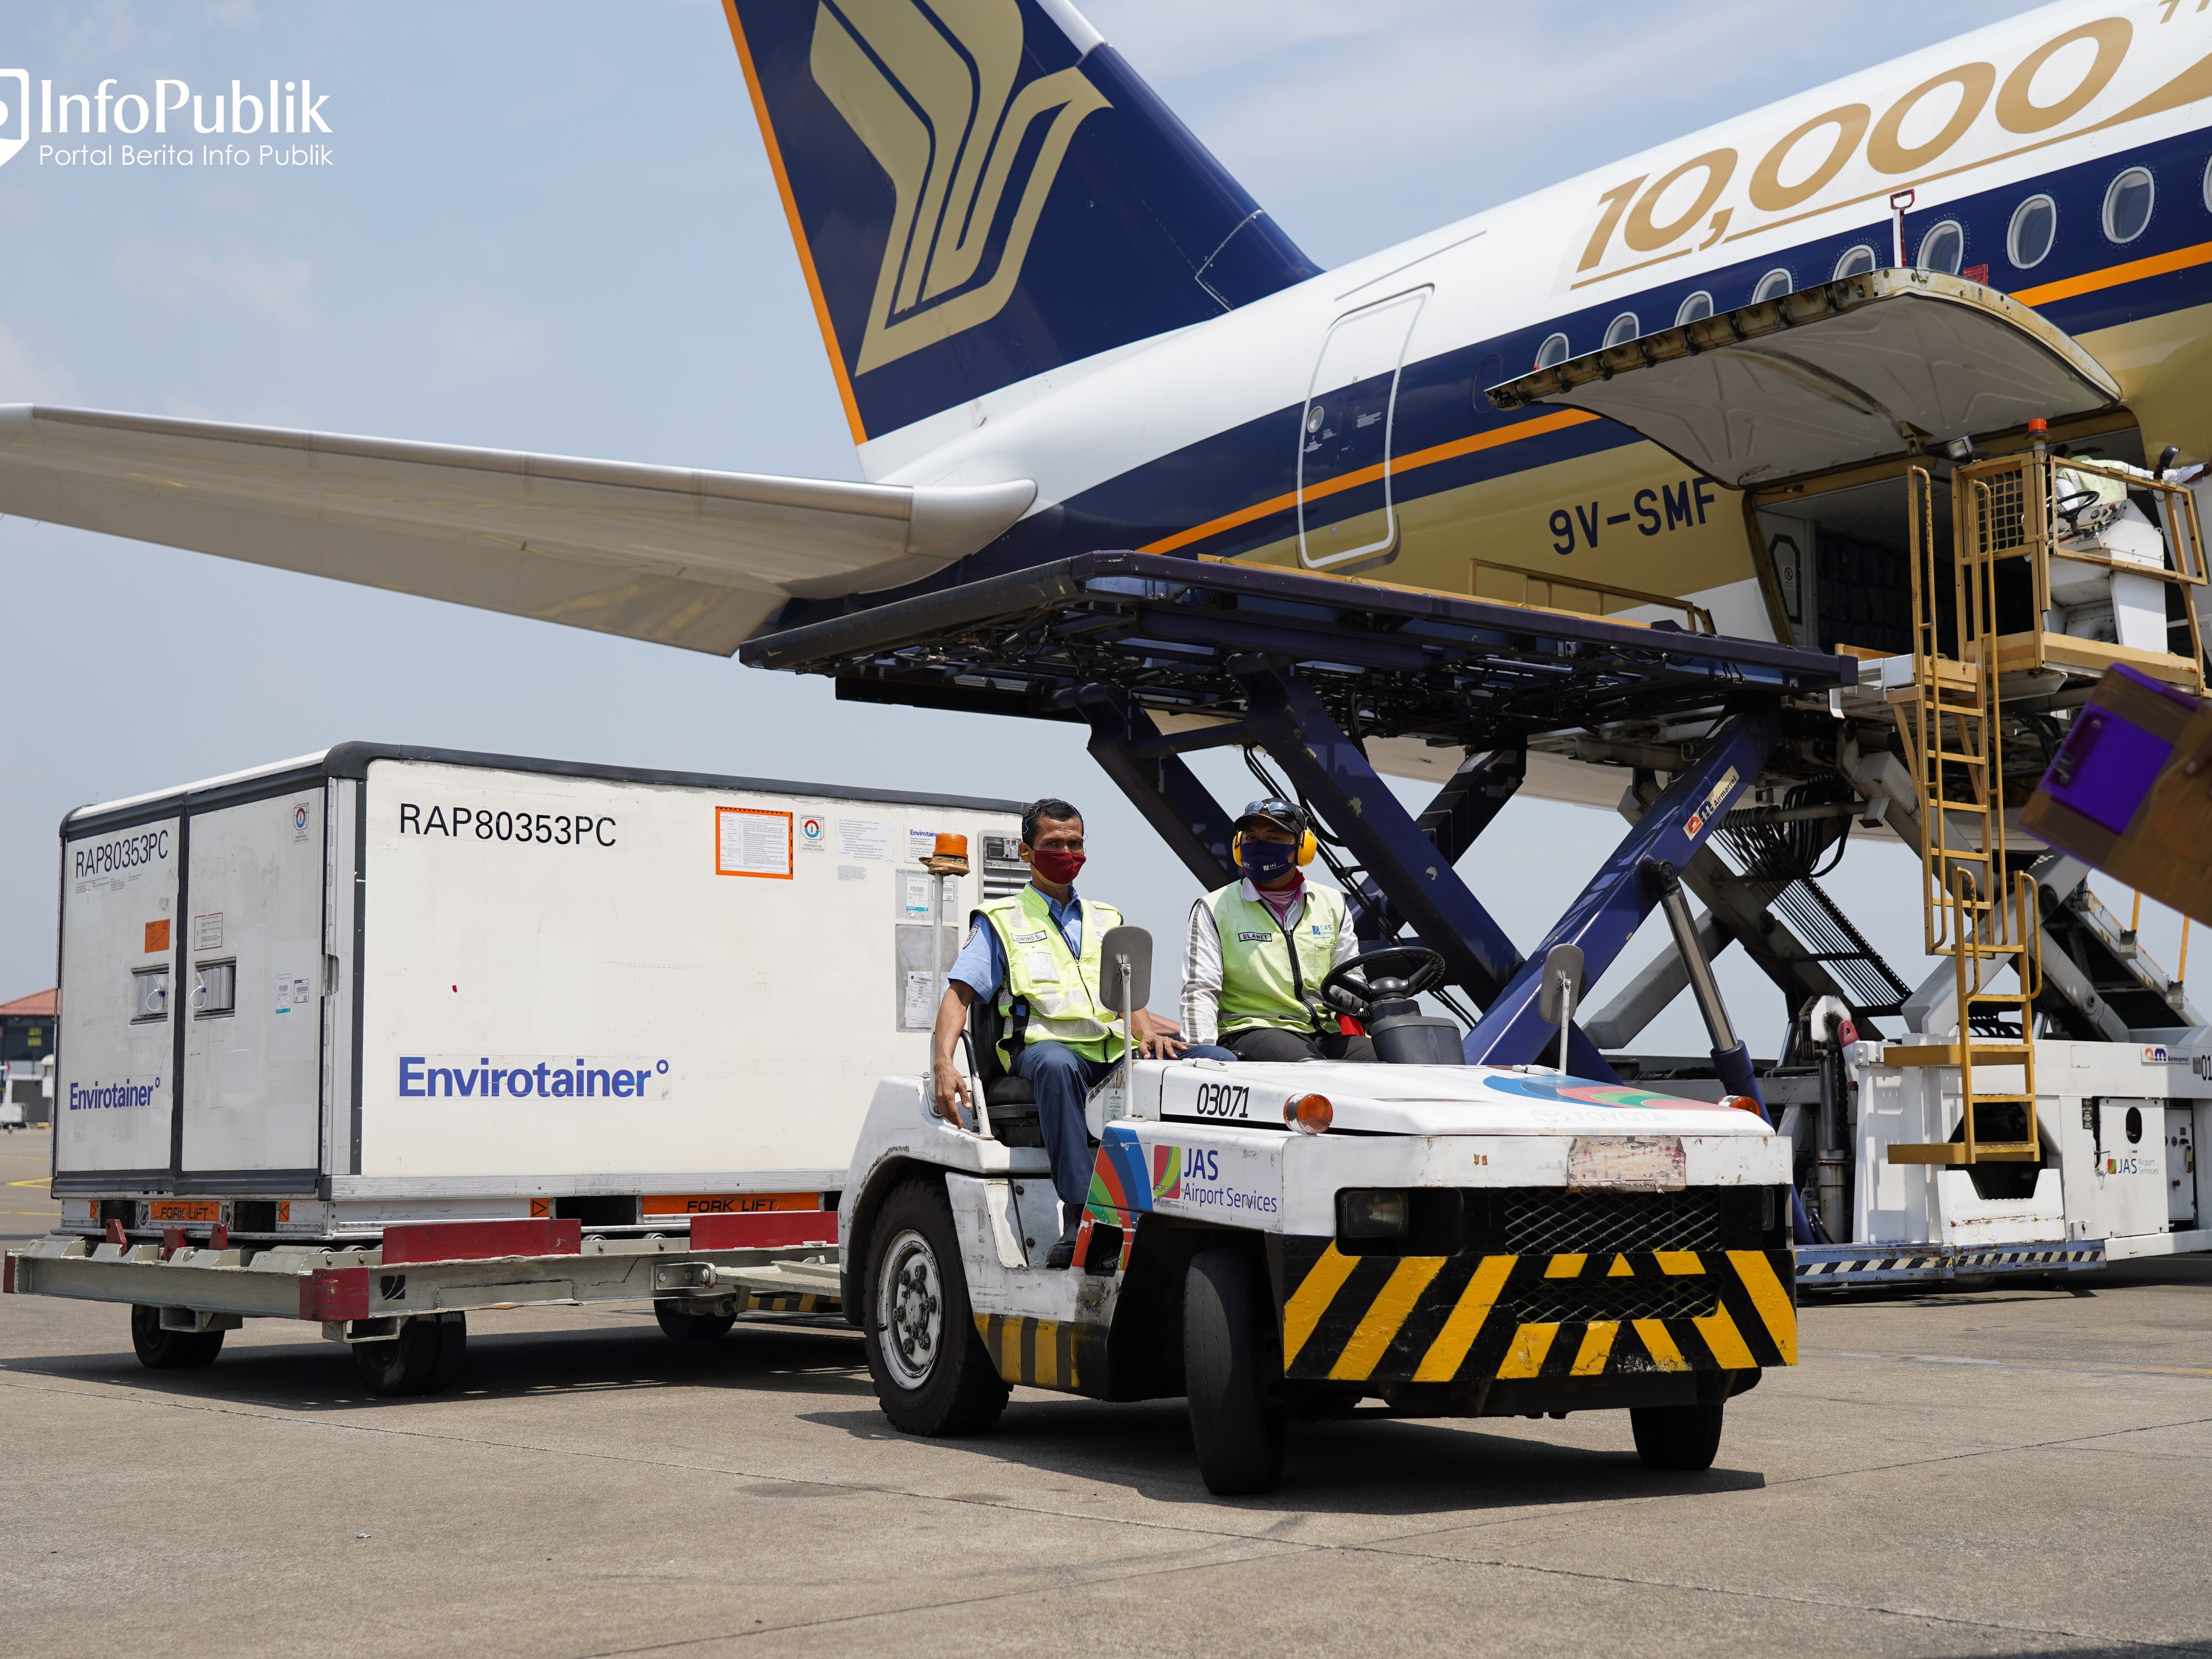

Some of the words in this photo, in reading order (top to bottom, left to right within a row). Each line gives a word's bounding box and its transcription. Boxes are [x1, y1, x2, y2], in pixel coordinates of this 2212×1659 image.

[1576, 16, 2133, 273] 10,000
[1549, 476, 1715, 555] 9V-SMF
[1714, 775, 1737, 807] Airmarrel
[400, 803, 616, 847] RAP80353PC
[76, 830, 168, 878] RAP80353PC
[1197, 1083, 1249, 1118] 03071
[1184, 1148, 1218, 1180] JAS
[2118, 1158, 2137, 1174] JAS
[160, 1207, 186, 1220] FORK
[189, 1207, 209, 1220] LIFT
[686, 1200, 735, 1212] FORK
[741, 1199, 778, 1211] LIFT
[1184, 1182, 1224, 1207] Airport
[1226, 1187, 1277, 1213] Services
